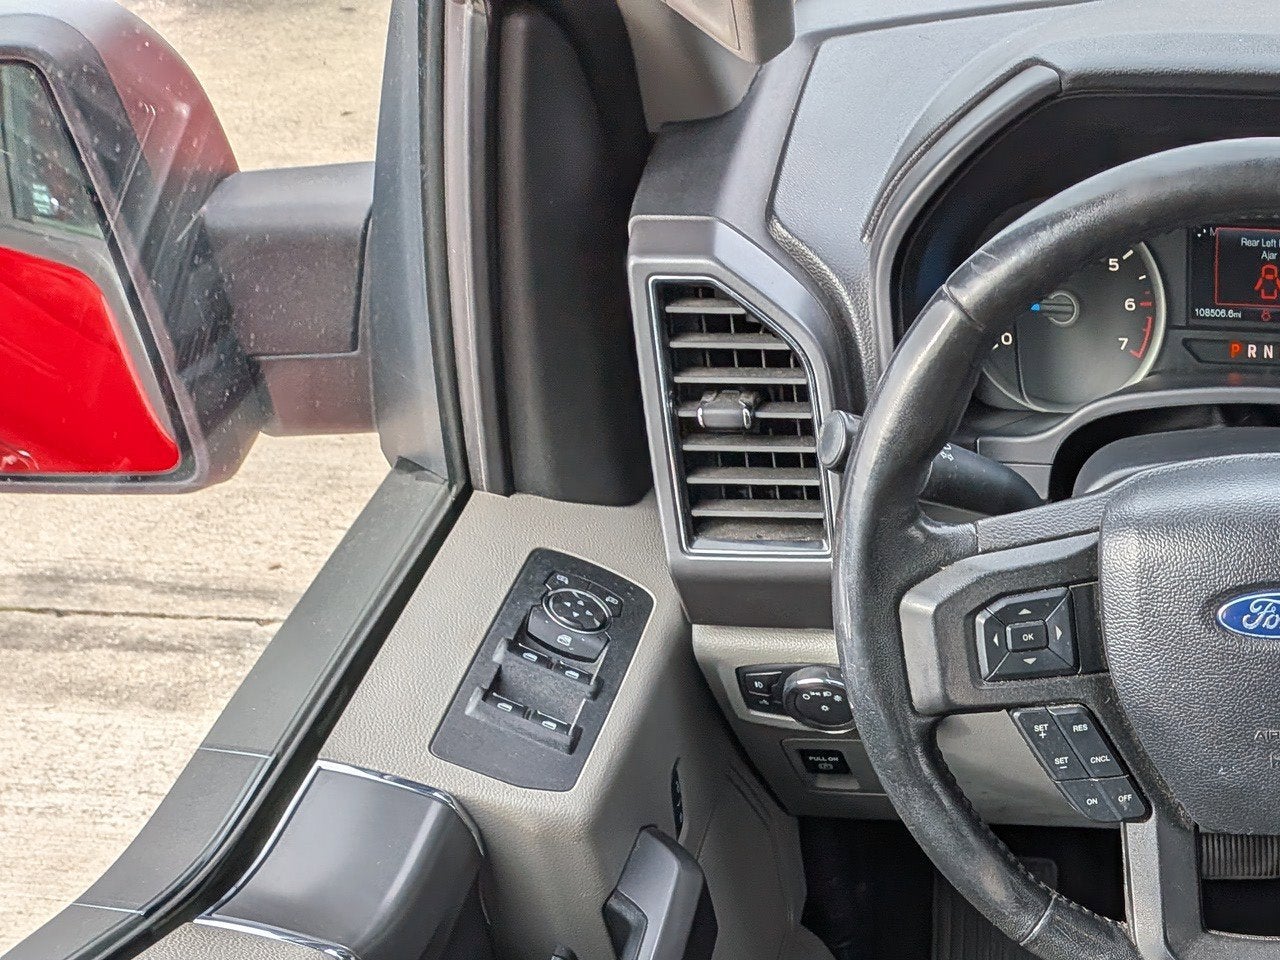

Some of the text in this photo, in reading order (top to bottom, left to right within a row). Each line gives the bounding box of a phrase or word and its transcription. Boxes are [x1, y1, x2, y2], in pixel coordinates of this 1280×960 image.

[1241, 238, 1259, 246] Rear
[1262, 238, 1276, 248] Left
[1261, 251, 1277, 260] Ajar
[1108, 258, 1119, 272] 5
[1124, 298, 1136, 311] 6
[1001, 332, 1012, 346] 0
[1118, 338, 1128, 350] 7
[1230, 342, 1240, 356] P
[1248, 344, 1256, 358] R
[1264, 345, 1274, 358] N
[1022, 633, 1034, 642] OK
[1034, 724, 1048, 732] SET
[1072, 724, 1088, 732] RES
[1054, 756, 1069, 764] SET
[1090, 755, 1110, 764] CNCL
[1086, 798, 1098, 806] ON
[1118, 795, 1132, 804] OFF
